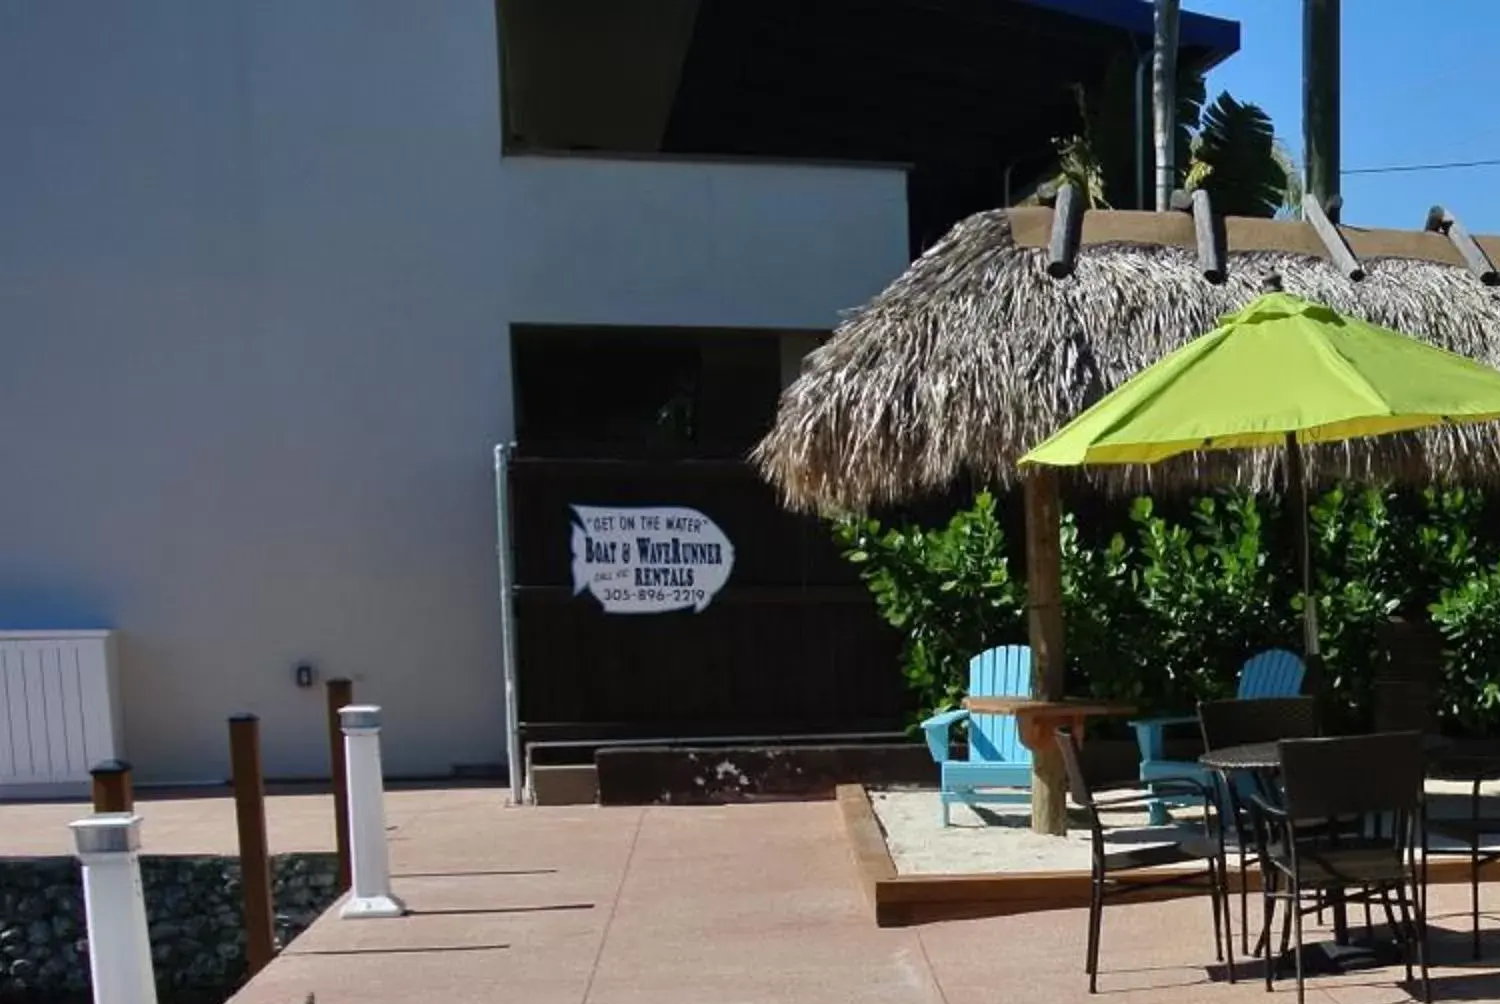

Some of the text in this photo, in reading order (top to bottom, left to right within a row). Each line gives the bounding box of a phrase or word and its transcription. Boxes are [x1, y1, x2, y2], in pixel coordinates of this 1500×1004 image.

[619, 517, 635, 531] ON
[641, 516, 660, 531] THE
[622, 542, 632, 564] &
[634, 567, 694, 587] RENTALS
[604, 588, 706, 602] 305-896-2219
